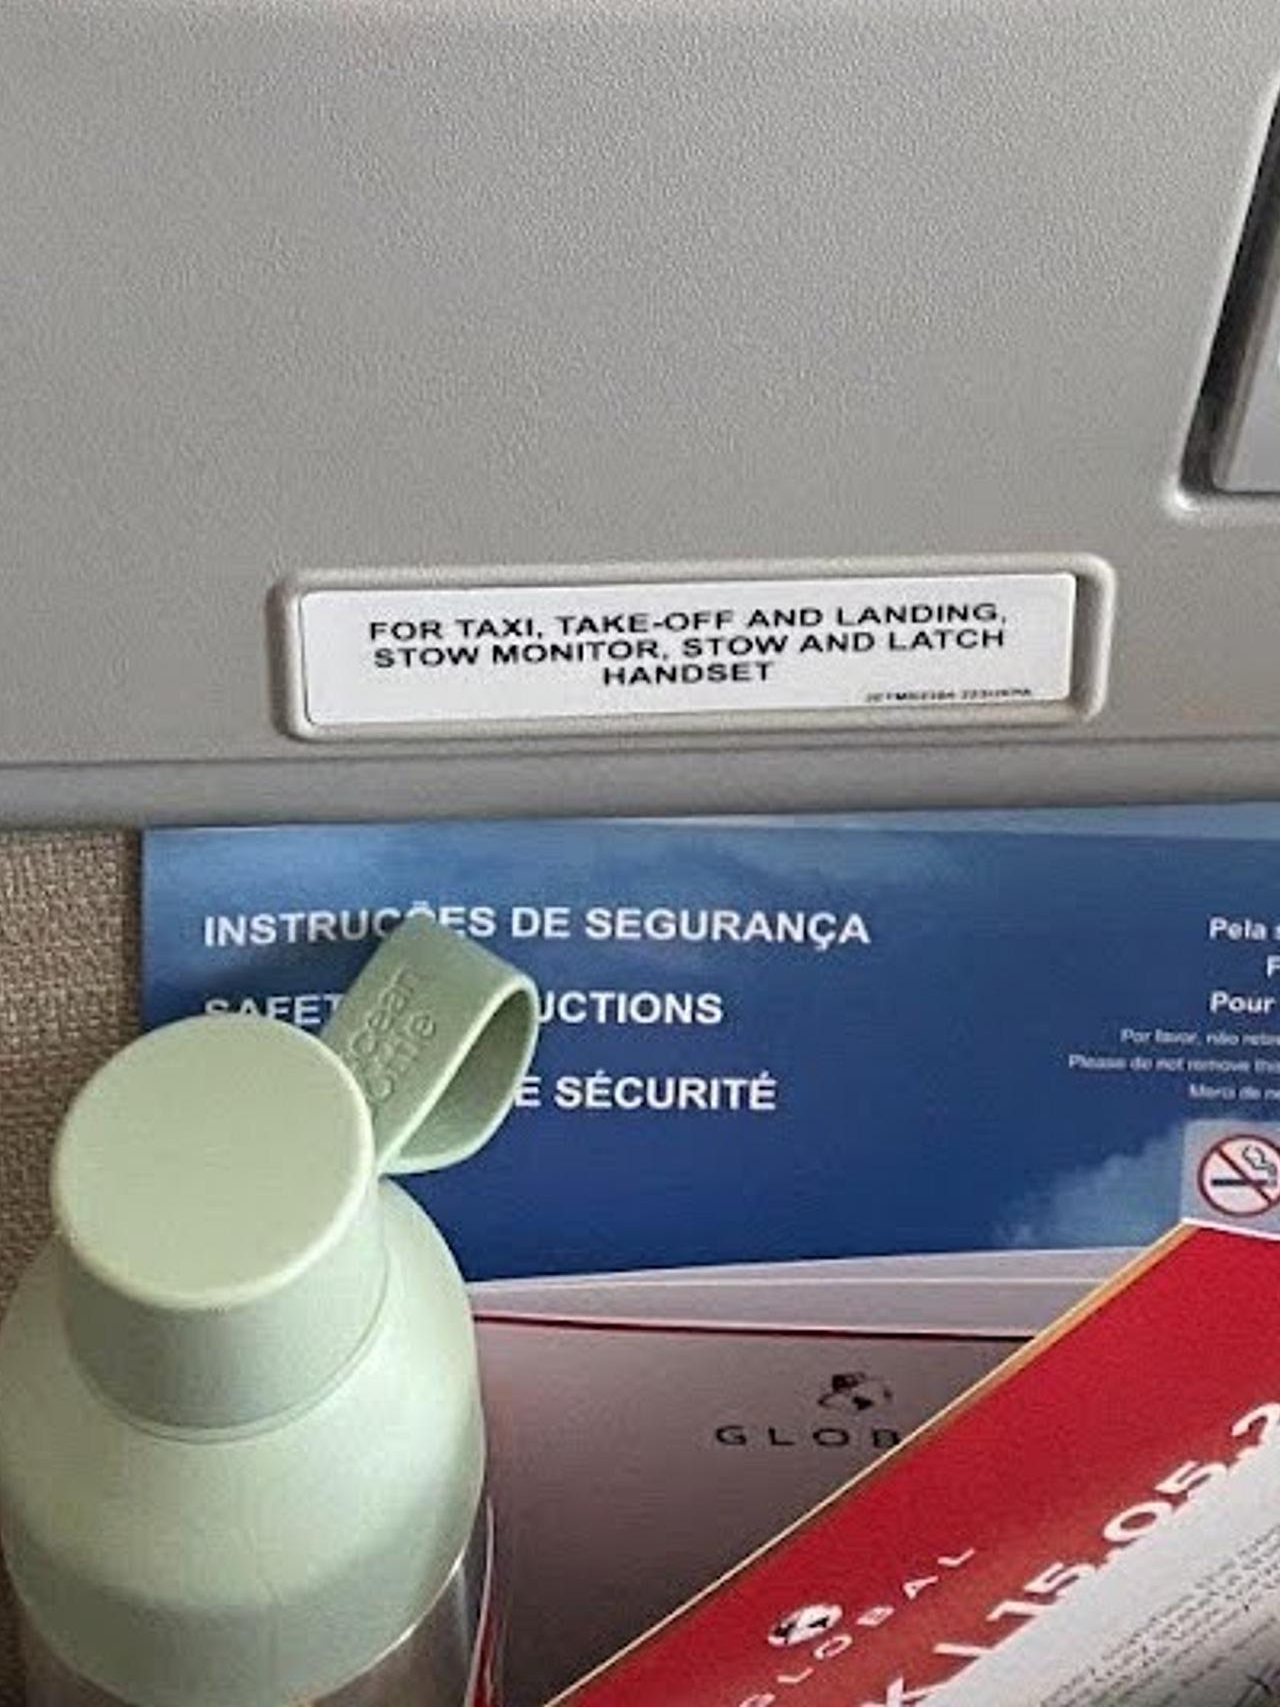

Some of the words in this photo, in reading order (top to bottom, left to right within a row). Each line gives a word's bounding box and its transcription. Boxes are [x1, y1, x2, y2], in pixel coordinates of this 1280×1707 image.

[370, 620, 443, 641] FOR
[455, 618, 544, 639] TAXI,
[555, 609, 734, 636] TAKE-OFF
[746, 607, 824, 628] AND
[836, 602, 1007, 626] LANDING,
[373, 645, 480, 668] STOW
[491, 638, 670, 665] MONITOR,
[682, 635, 789, 658] STOW
[799, 631, 876, 653] AND
[888, 628, 1006, 651] LATCH
[603, 661, 775, 686] HANDSET
[511, 906, 570, 939] DE
[585, 907, 871, 951] SEGURANÇA
[1209, 917, 1268, 940] Pela
[1209, 990, 1275, 1014] Pour
[554, 1070, 778, 1111] SÉCURITÉ
[716, 1425, 901, 1448] GLOB
